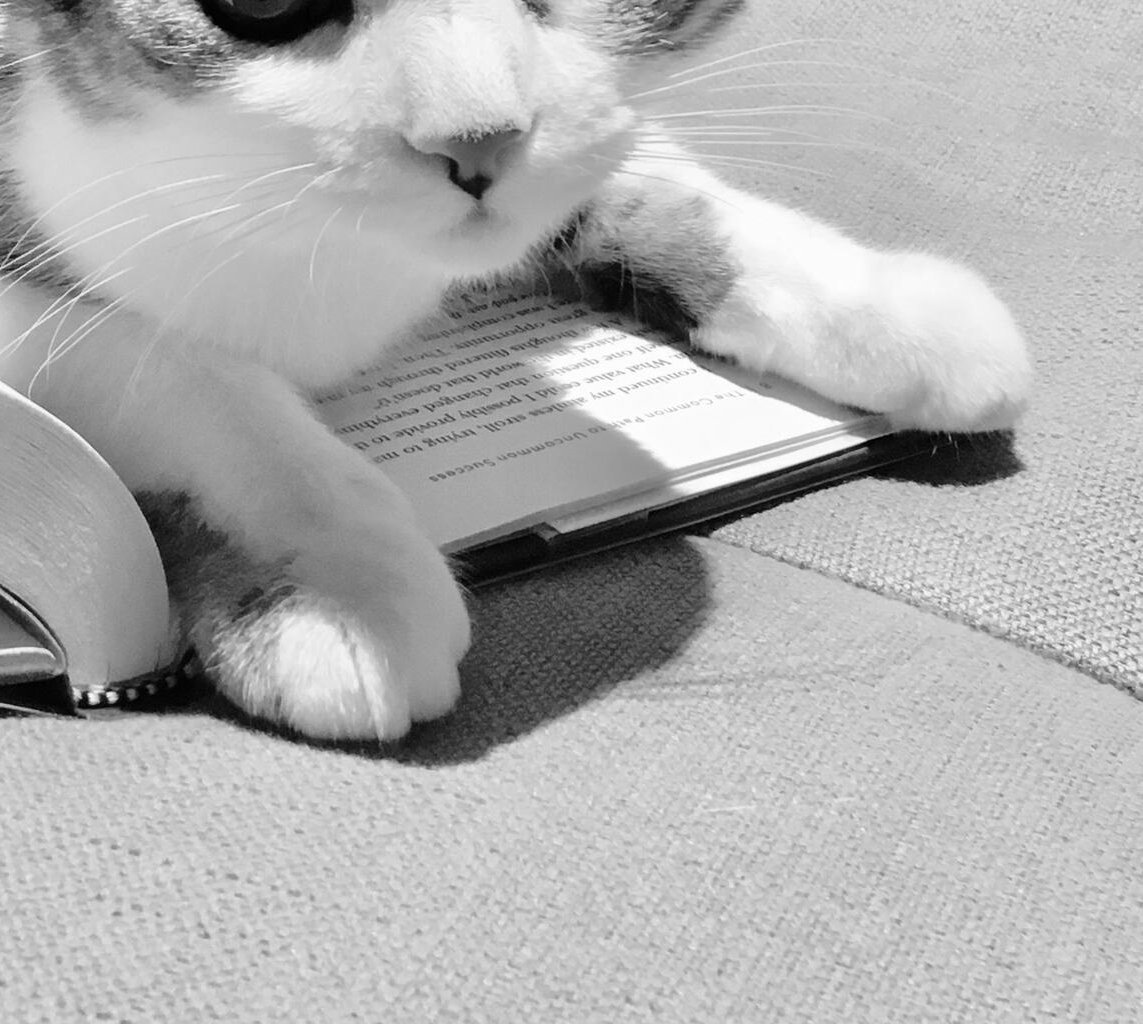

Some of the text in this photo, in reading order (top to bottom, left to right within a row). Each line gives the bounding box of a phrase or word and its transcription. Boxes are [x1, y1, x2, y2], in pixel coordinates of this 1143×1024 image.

[510, 330, 581, 351] thoughts
[577, 335, 627, 353] existed
[604, 351, 633, 360] one
[479, 362, 526, 379] world
[531, 359, 600, 384] question
[626, 359, 671, 372] What
[376, 367, 443, 388] through
[442, 372, 479, 387] that
[495, 378, 530, 390] that
[585, 370, 626, 383] value
[618, 369, 697, 392] continued
[423, 388, 493, 412] changed
[525, 391, 537, 400] I
[590, 390, 617, 400] my
[458, 395, 523, 419] possibly
[394, 413, 457, 437] provide
[477, 415, 528, 431] stroll,
[371, 435, 392, 443] to
[422, 425, 479, 447] trying
[429, 387, 745, 482] The Common Path to Uncommon Success
[403, 440, 423, 453] to
